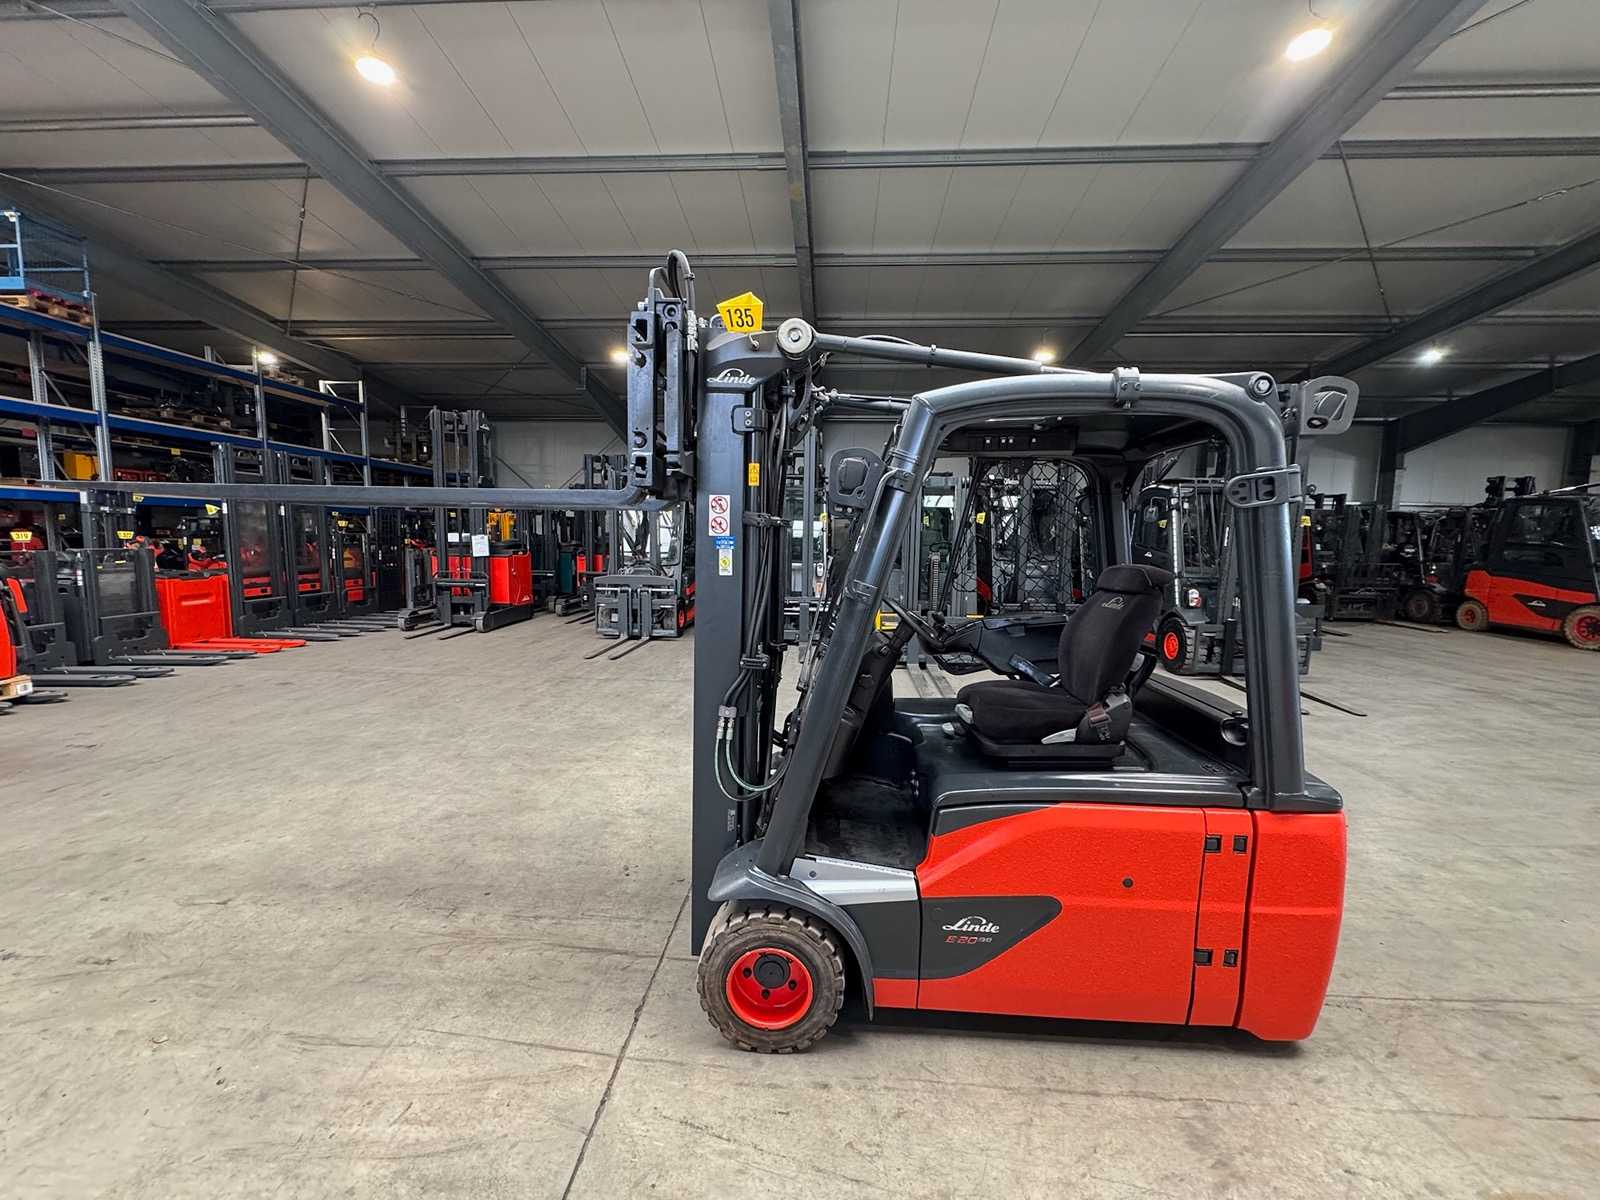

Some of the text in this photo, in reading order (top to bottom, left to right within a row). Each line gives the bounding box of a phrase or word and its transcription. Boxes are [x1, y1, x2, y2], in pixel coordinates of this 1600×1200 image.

[726, 308, 755, 328] 135
[706, 367, 757, 385] Linde
[942, 915, 1000, 933] Linde
